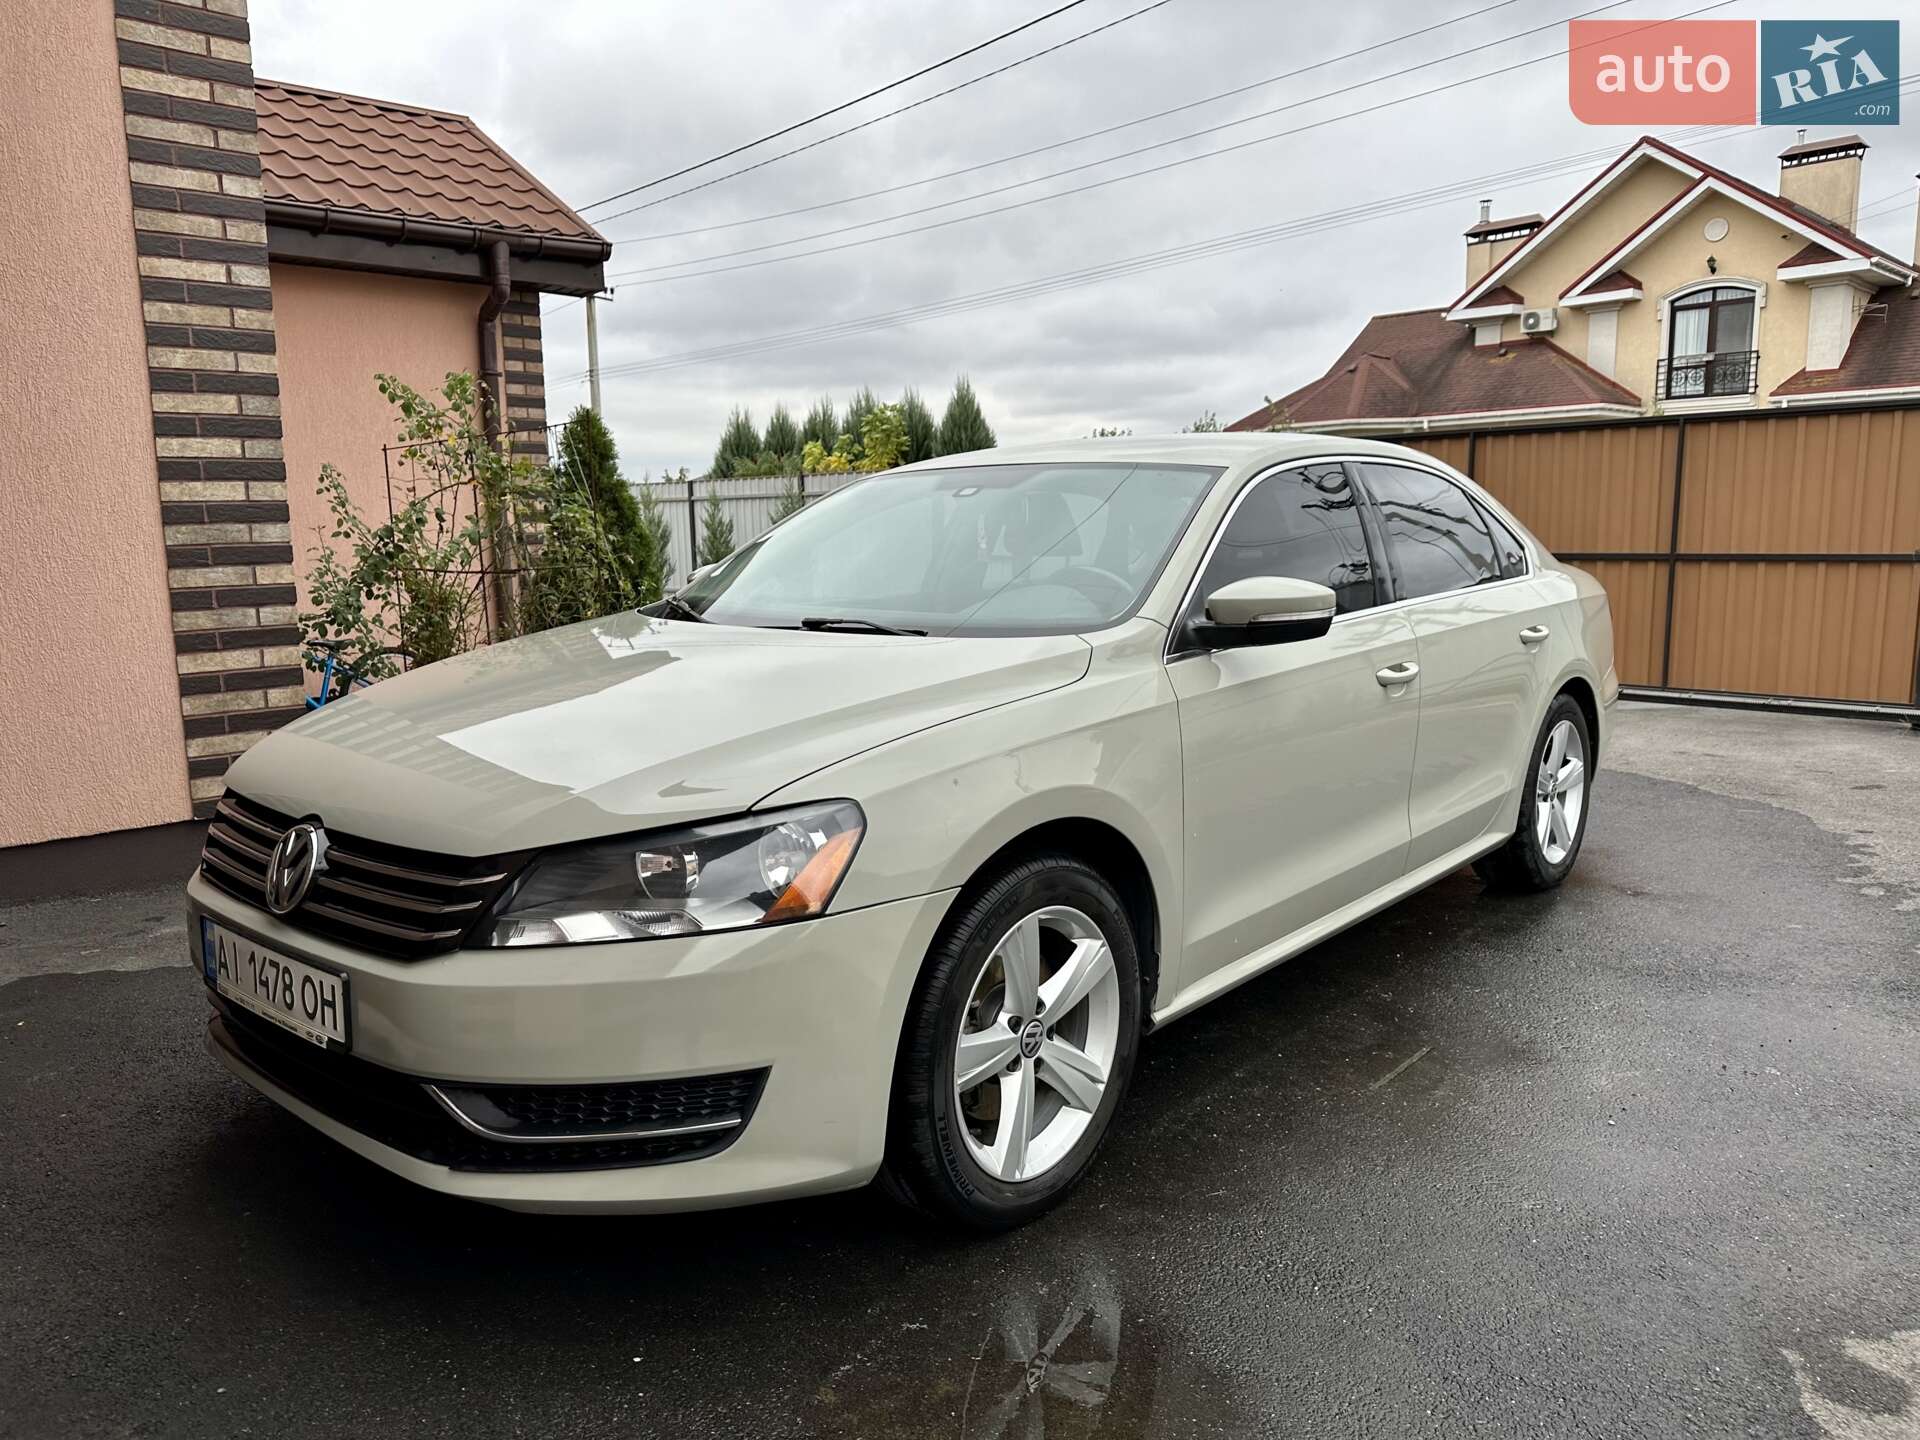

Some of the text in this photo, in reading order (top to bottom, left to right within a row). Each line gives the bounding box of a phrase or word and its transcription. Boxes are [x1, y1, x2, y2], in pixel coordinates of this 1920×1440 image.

[217, 935, 338, 1031] AI 1478 OH
